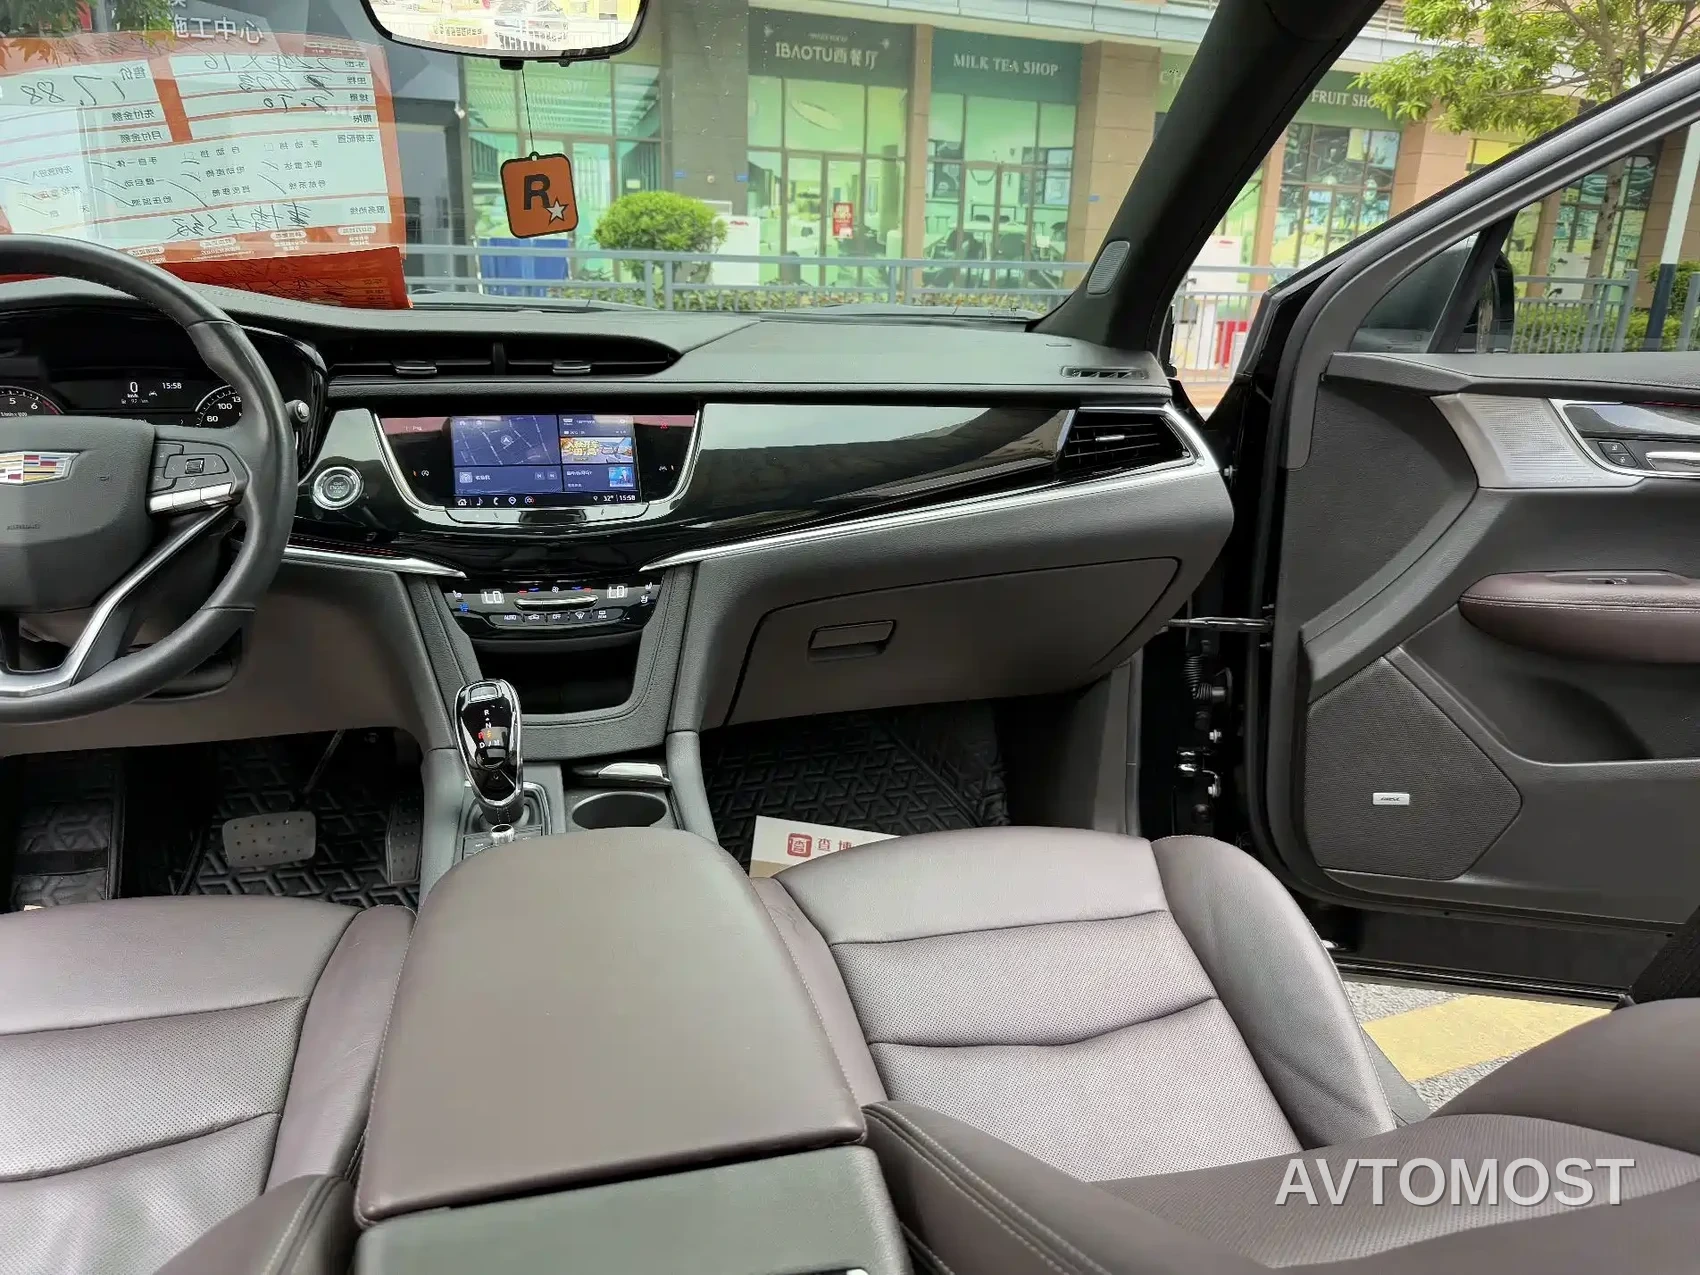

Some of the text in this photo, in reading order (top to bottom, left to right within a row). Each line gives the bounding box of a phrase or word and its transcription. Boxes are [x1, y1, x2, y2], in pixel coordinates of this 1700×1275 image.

[953, 53, 1059, 76] MILK TEA SHOP
[1311, 90, 1382, 109] FRUIT SHO
[524, 174, 551, 210] R
[129, 381, 139, 394] 0
[162, 382, 182, 390] 15:58
[30, 402, 39, 410] 6
[206, 415, 219, 423] 80
